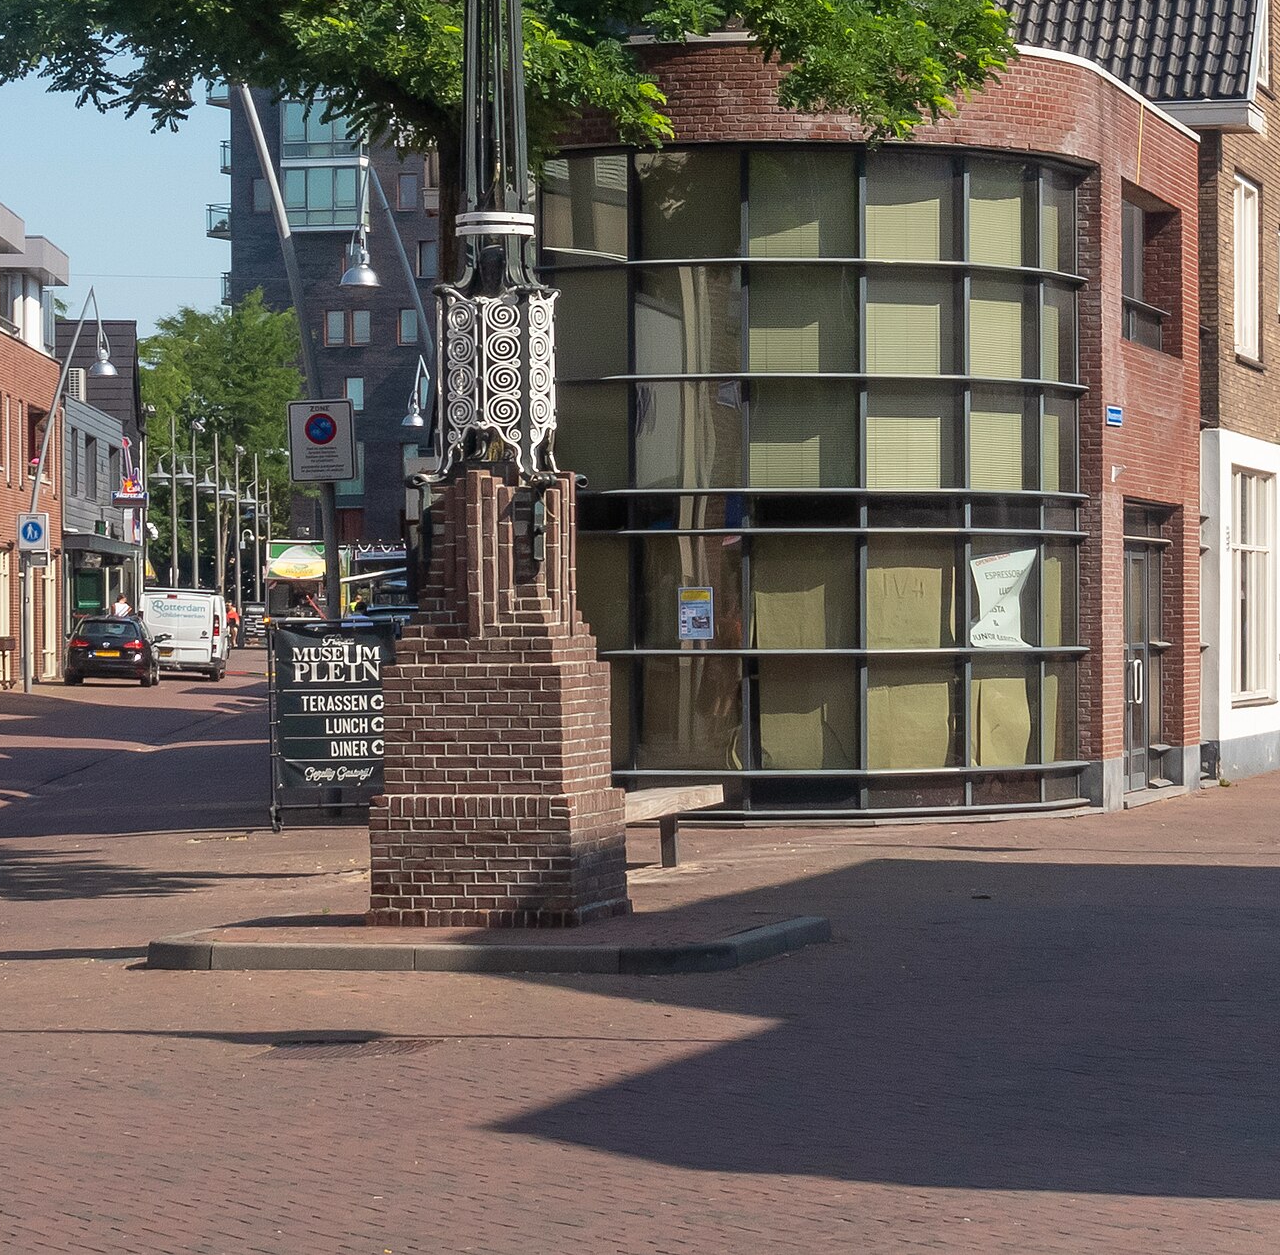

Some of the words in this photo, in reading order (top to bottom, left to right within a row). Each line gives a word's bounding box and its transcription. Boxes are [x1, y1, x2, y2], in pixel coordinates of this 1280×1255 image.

[309, 405, 330, 413] ZONE
[151, 600, 206, 612] Rotterdam
[291, 645, 382, 666] MUSEUM
[292, 661, 382, 684] PLEIN
[301, 695, 369, 712] TERASSEN
[325, 718, 369, 734] LUNCH
[330, 740, 369, 757] DINER
